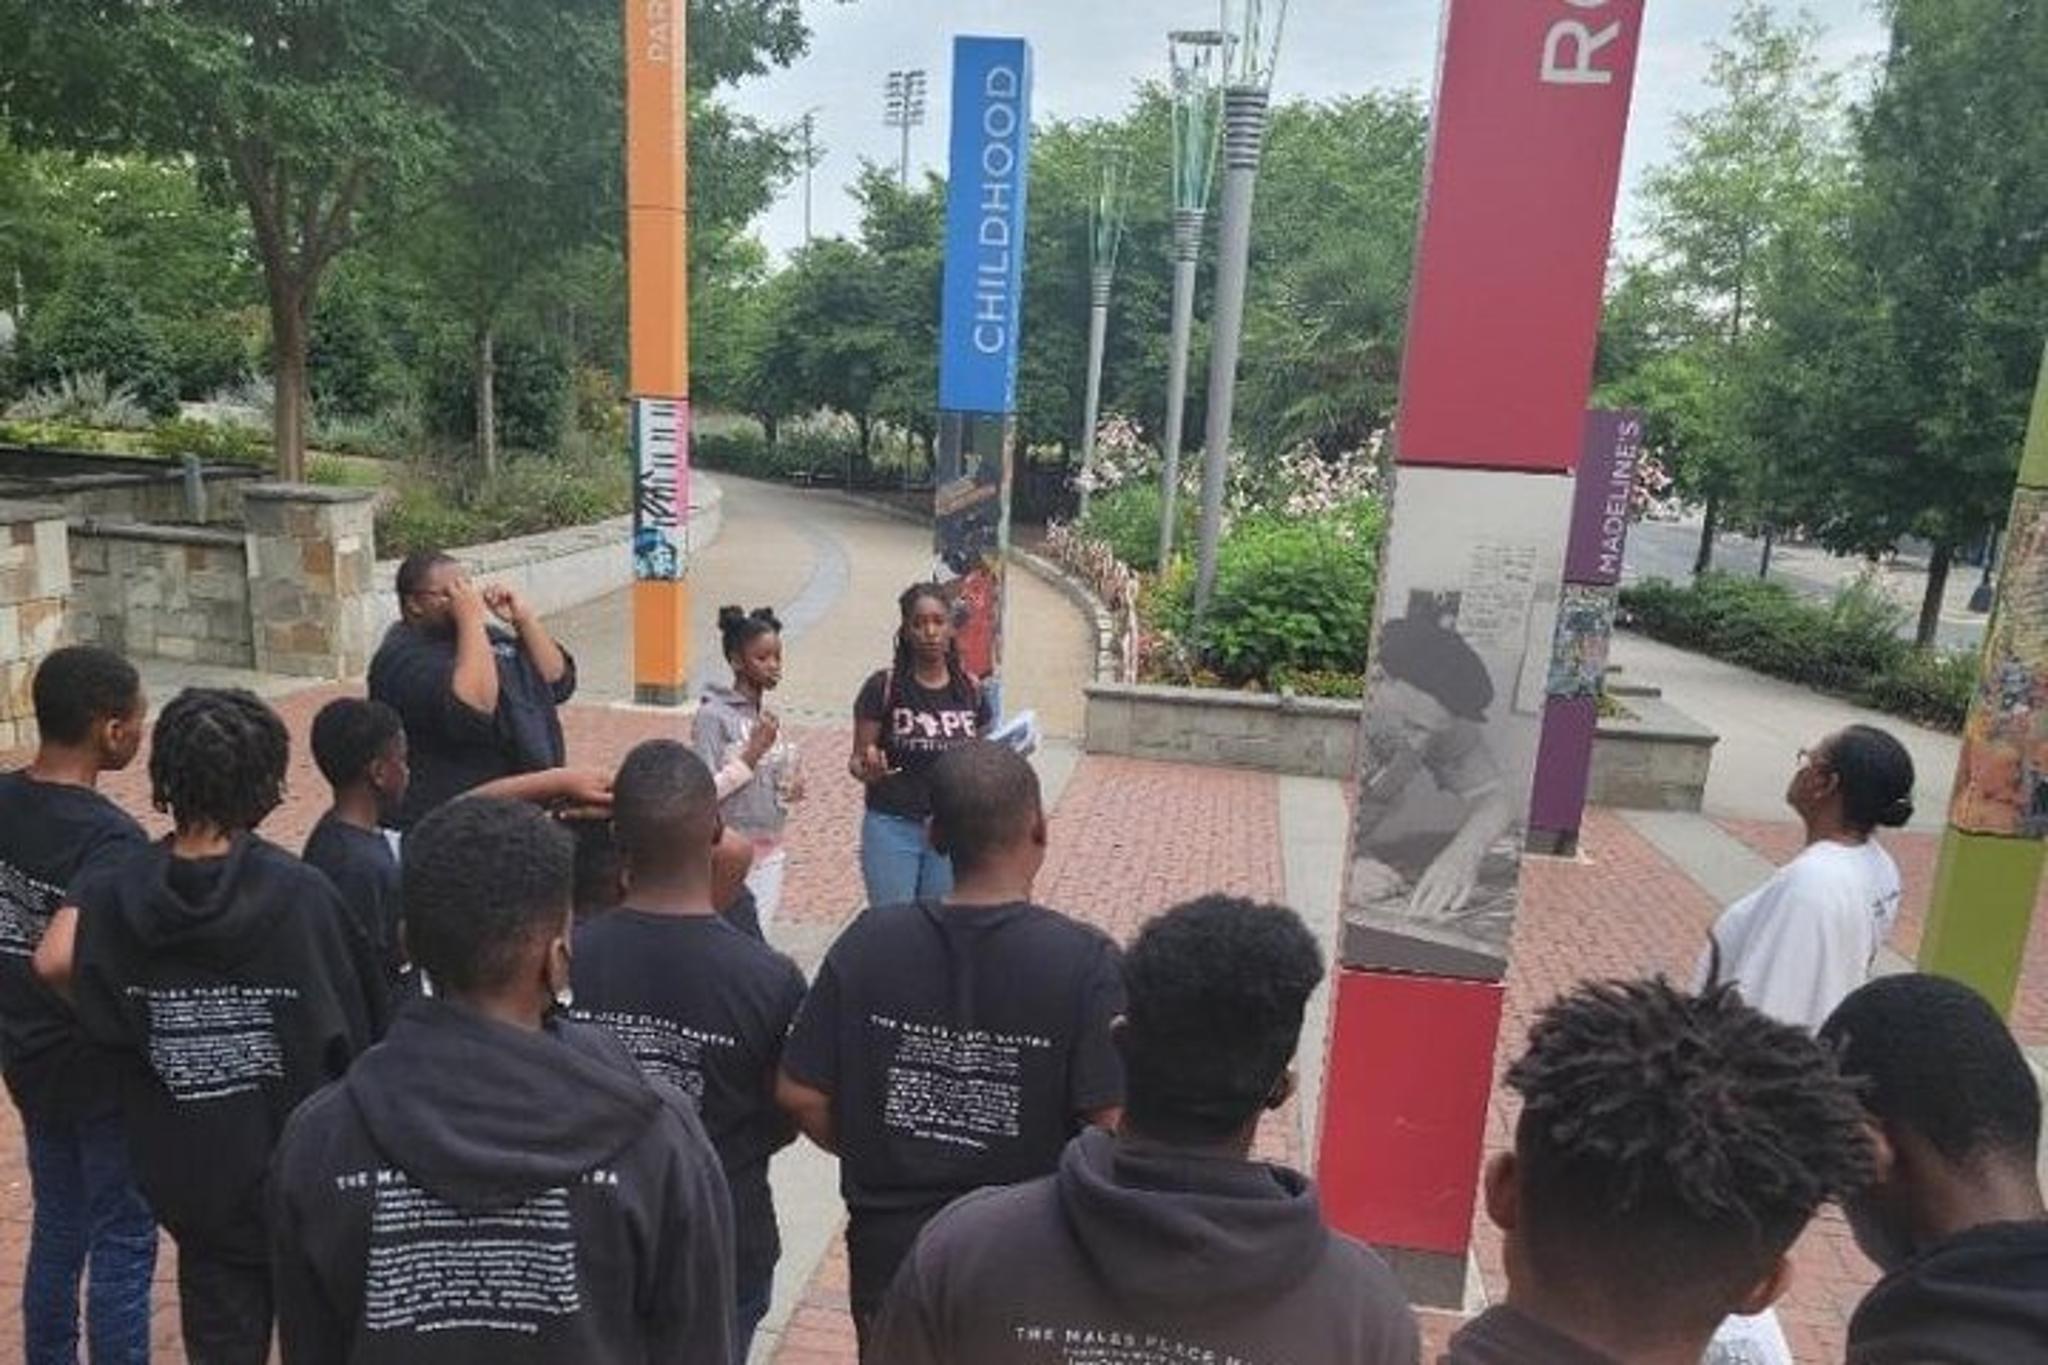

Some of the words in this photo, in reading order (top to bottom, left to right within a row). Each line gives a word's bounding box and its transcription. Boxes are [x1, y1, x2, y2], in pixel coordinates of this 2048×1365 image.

[1540, 0, 1623, 84] R
[974, 66, 1018, 354] CHILDHOOD
[1597, 420, 1641, 574] MADELINE'S
[1015, 1326, 1054, 1343] THE
